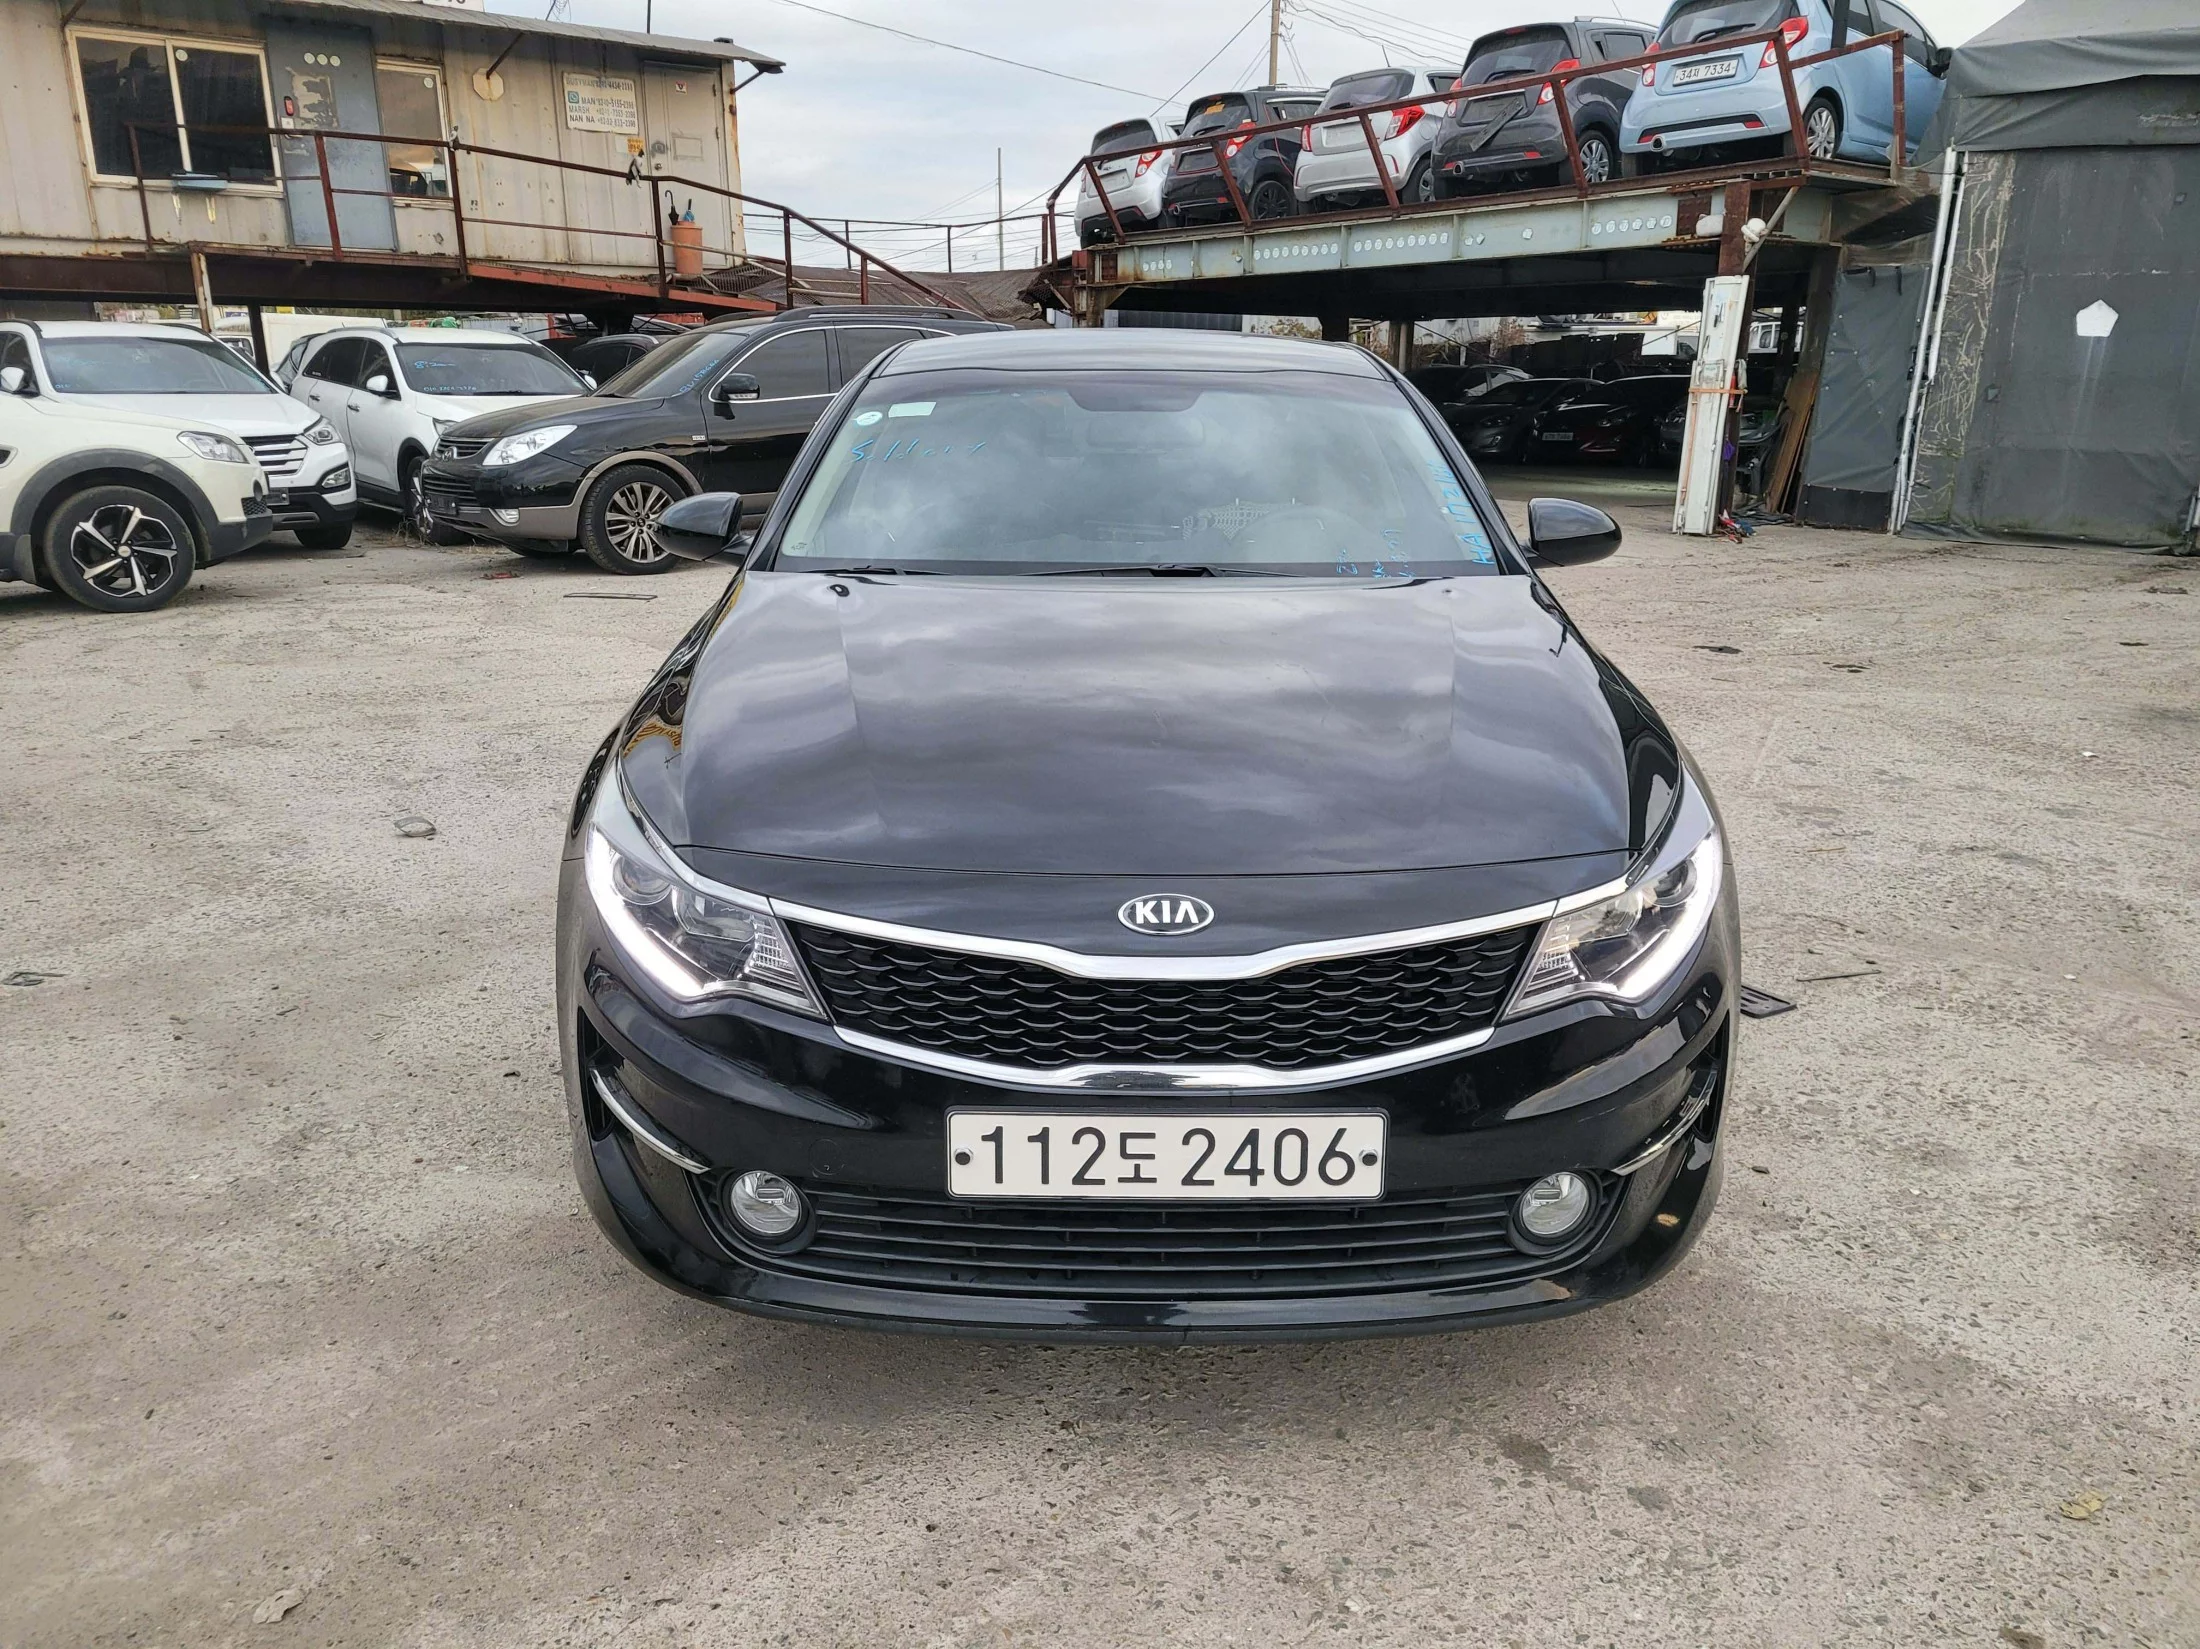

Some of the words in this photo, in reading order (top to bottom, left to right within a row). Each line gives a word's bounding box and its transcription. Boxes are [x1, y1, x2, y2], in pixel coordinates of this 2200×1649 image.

[1704, 62, 1732, 76] 7334
[569, 114, 584, 123] NAN
[586, 115, 595, 124] NA
[1134, 900, 1200, 924] KIA
[981, 1125, 1158, 1186] 112도
[1181, 1126, 1356, 1187] 2406
